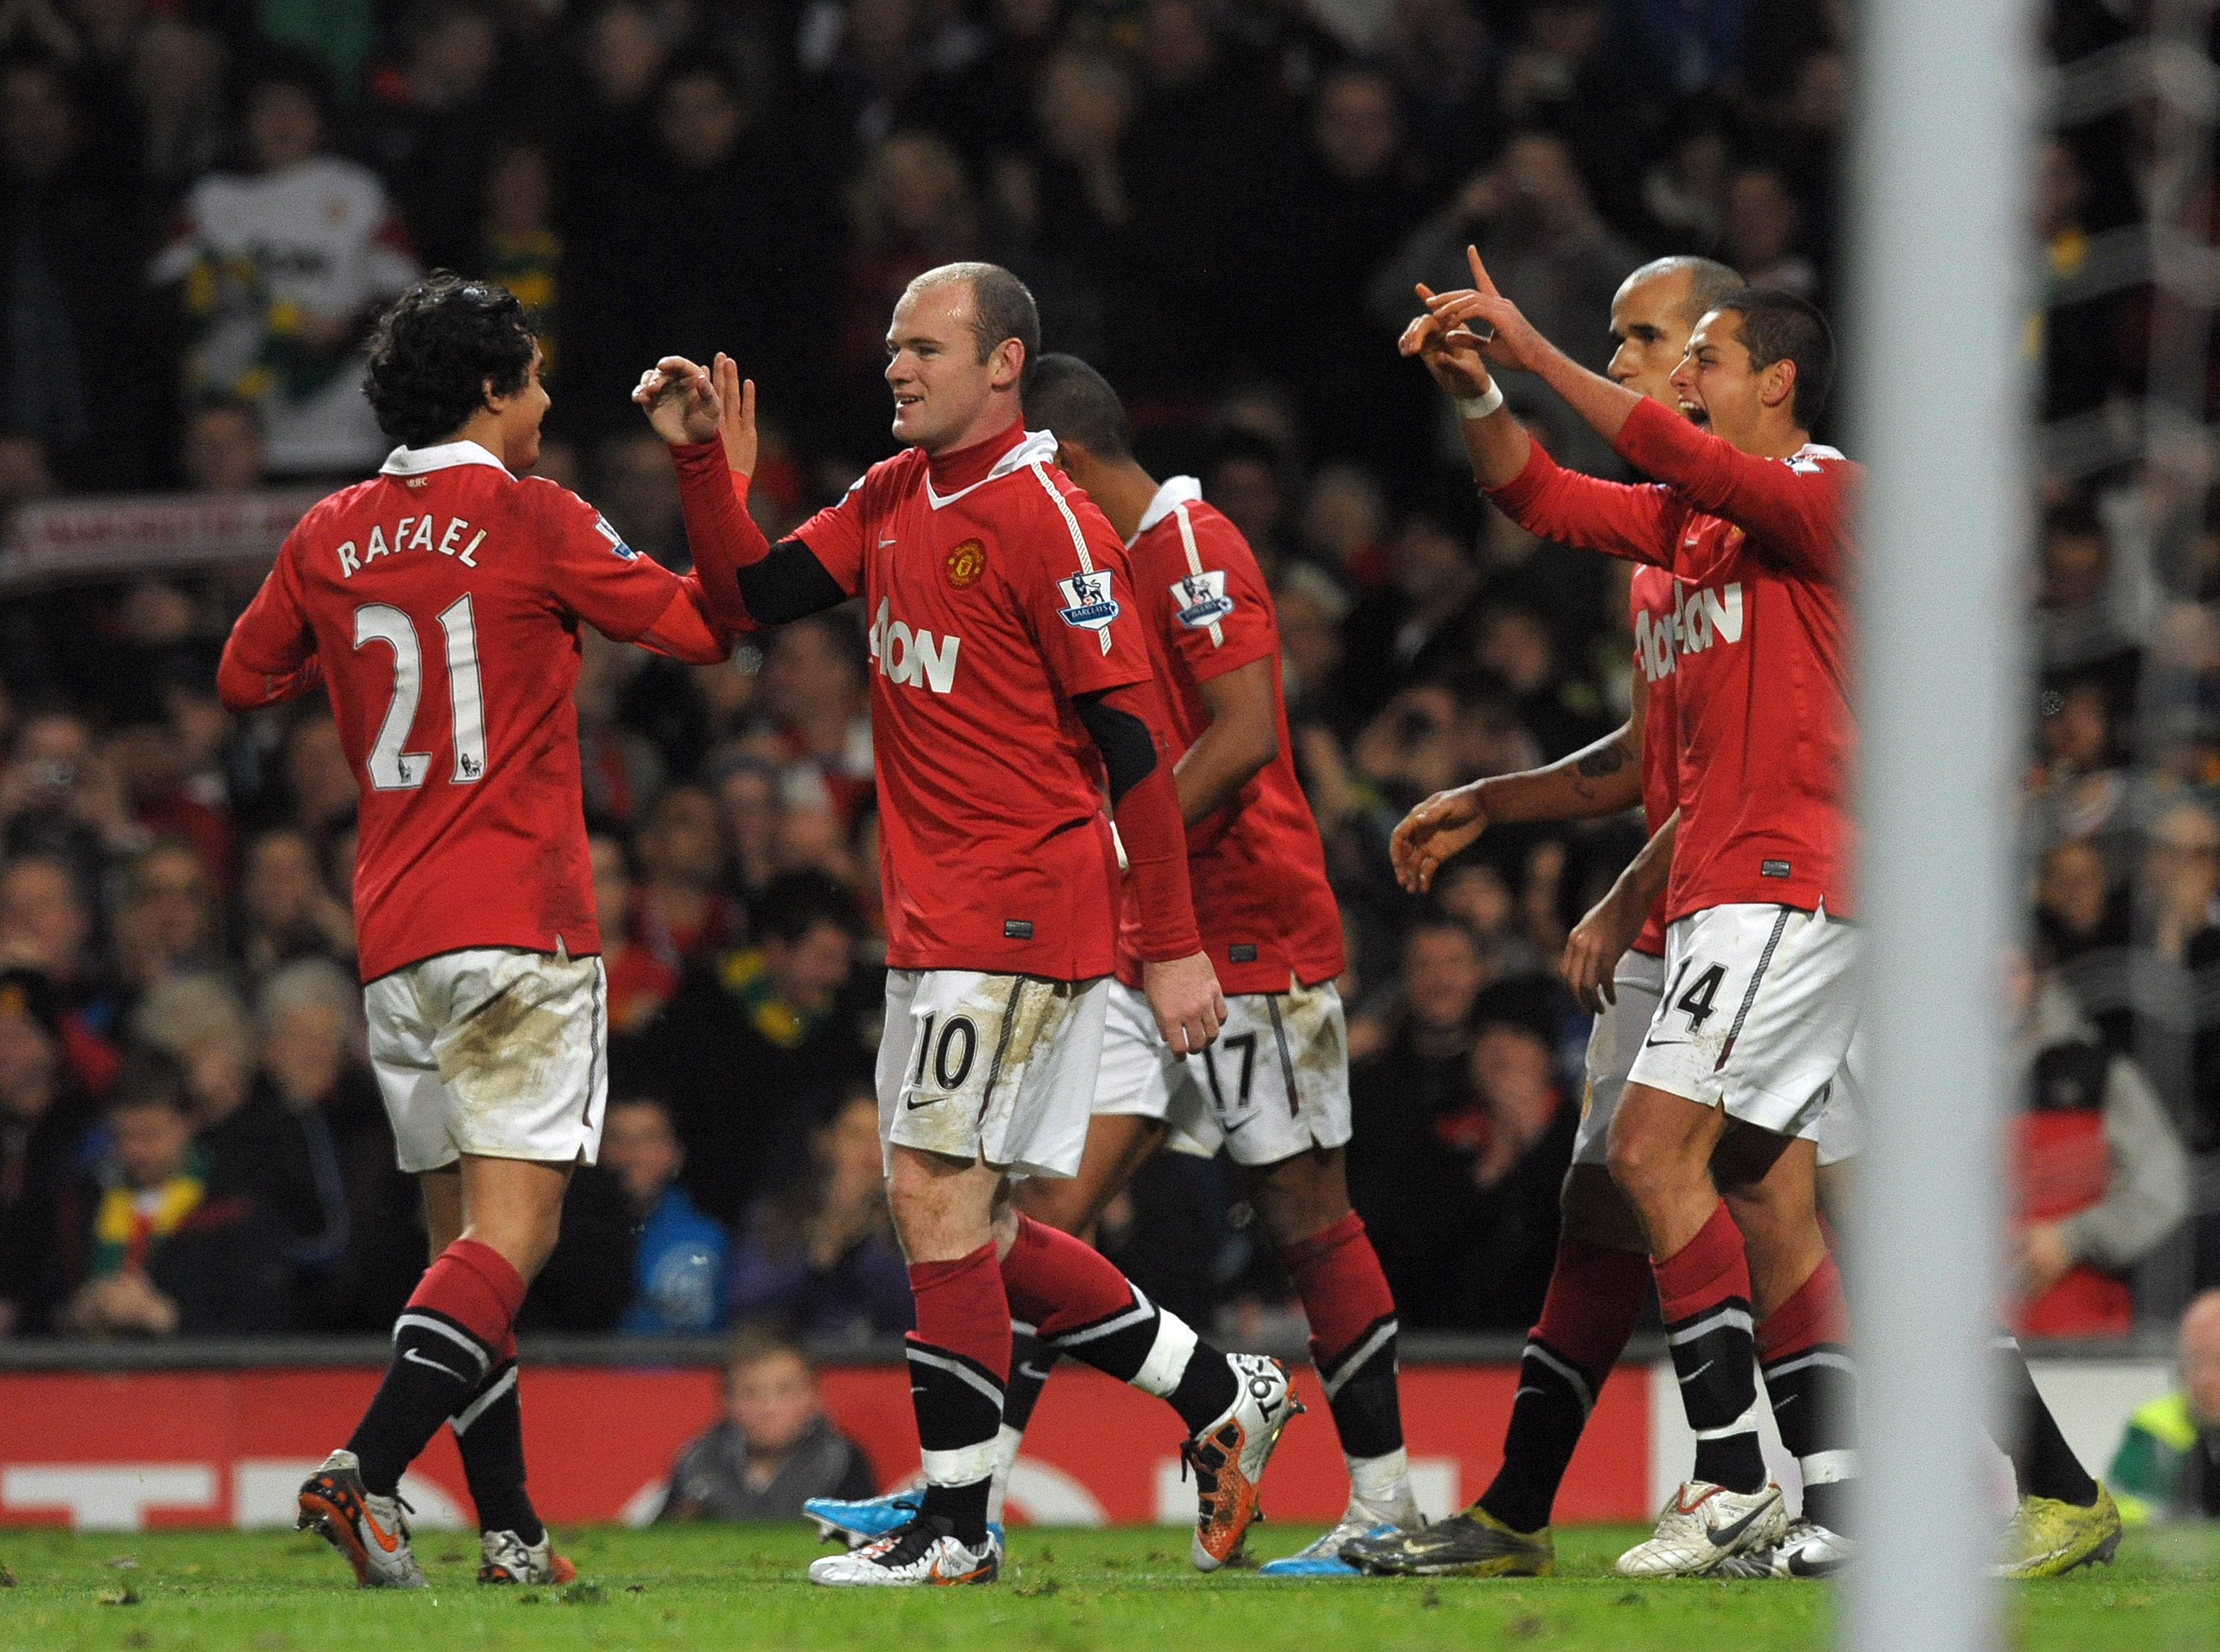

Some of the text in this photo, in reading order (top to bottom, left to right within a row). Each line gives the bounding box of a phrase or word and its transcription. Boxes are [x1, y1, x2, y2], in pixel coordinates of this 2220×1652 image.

[337, 513, 488, 579] RAFAEL
[868, 595, 961, 694] AON
[1071, 604, 1109, 618] BARCLAYS
[354, 592, 488, 791] 21
[1652, 955, 1729, 1036] 14
[911, 1010, 979, 1093] 10
[1202, 1030, 1257, 1112] 17
